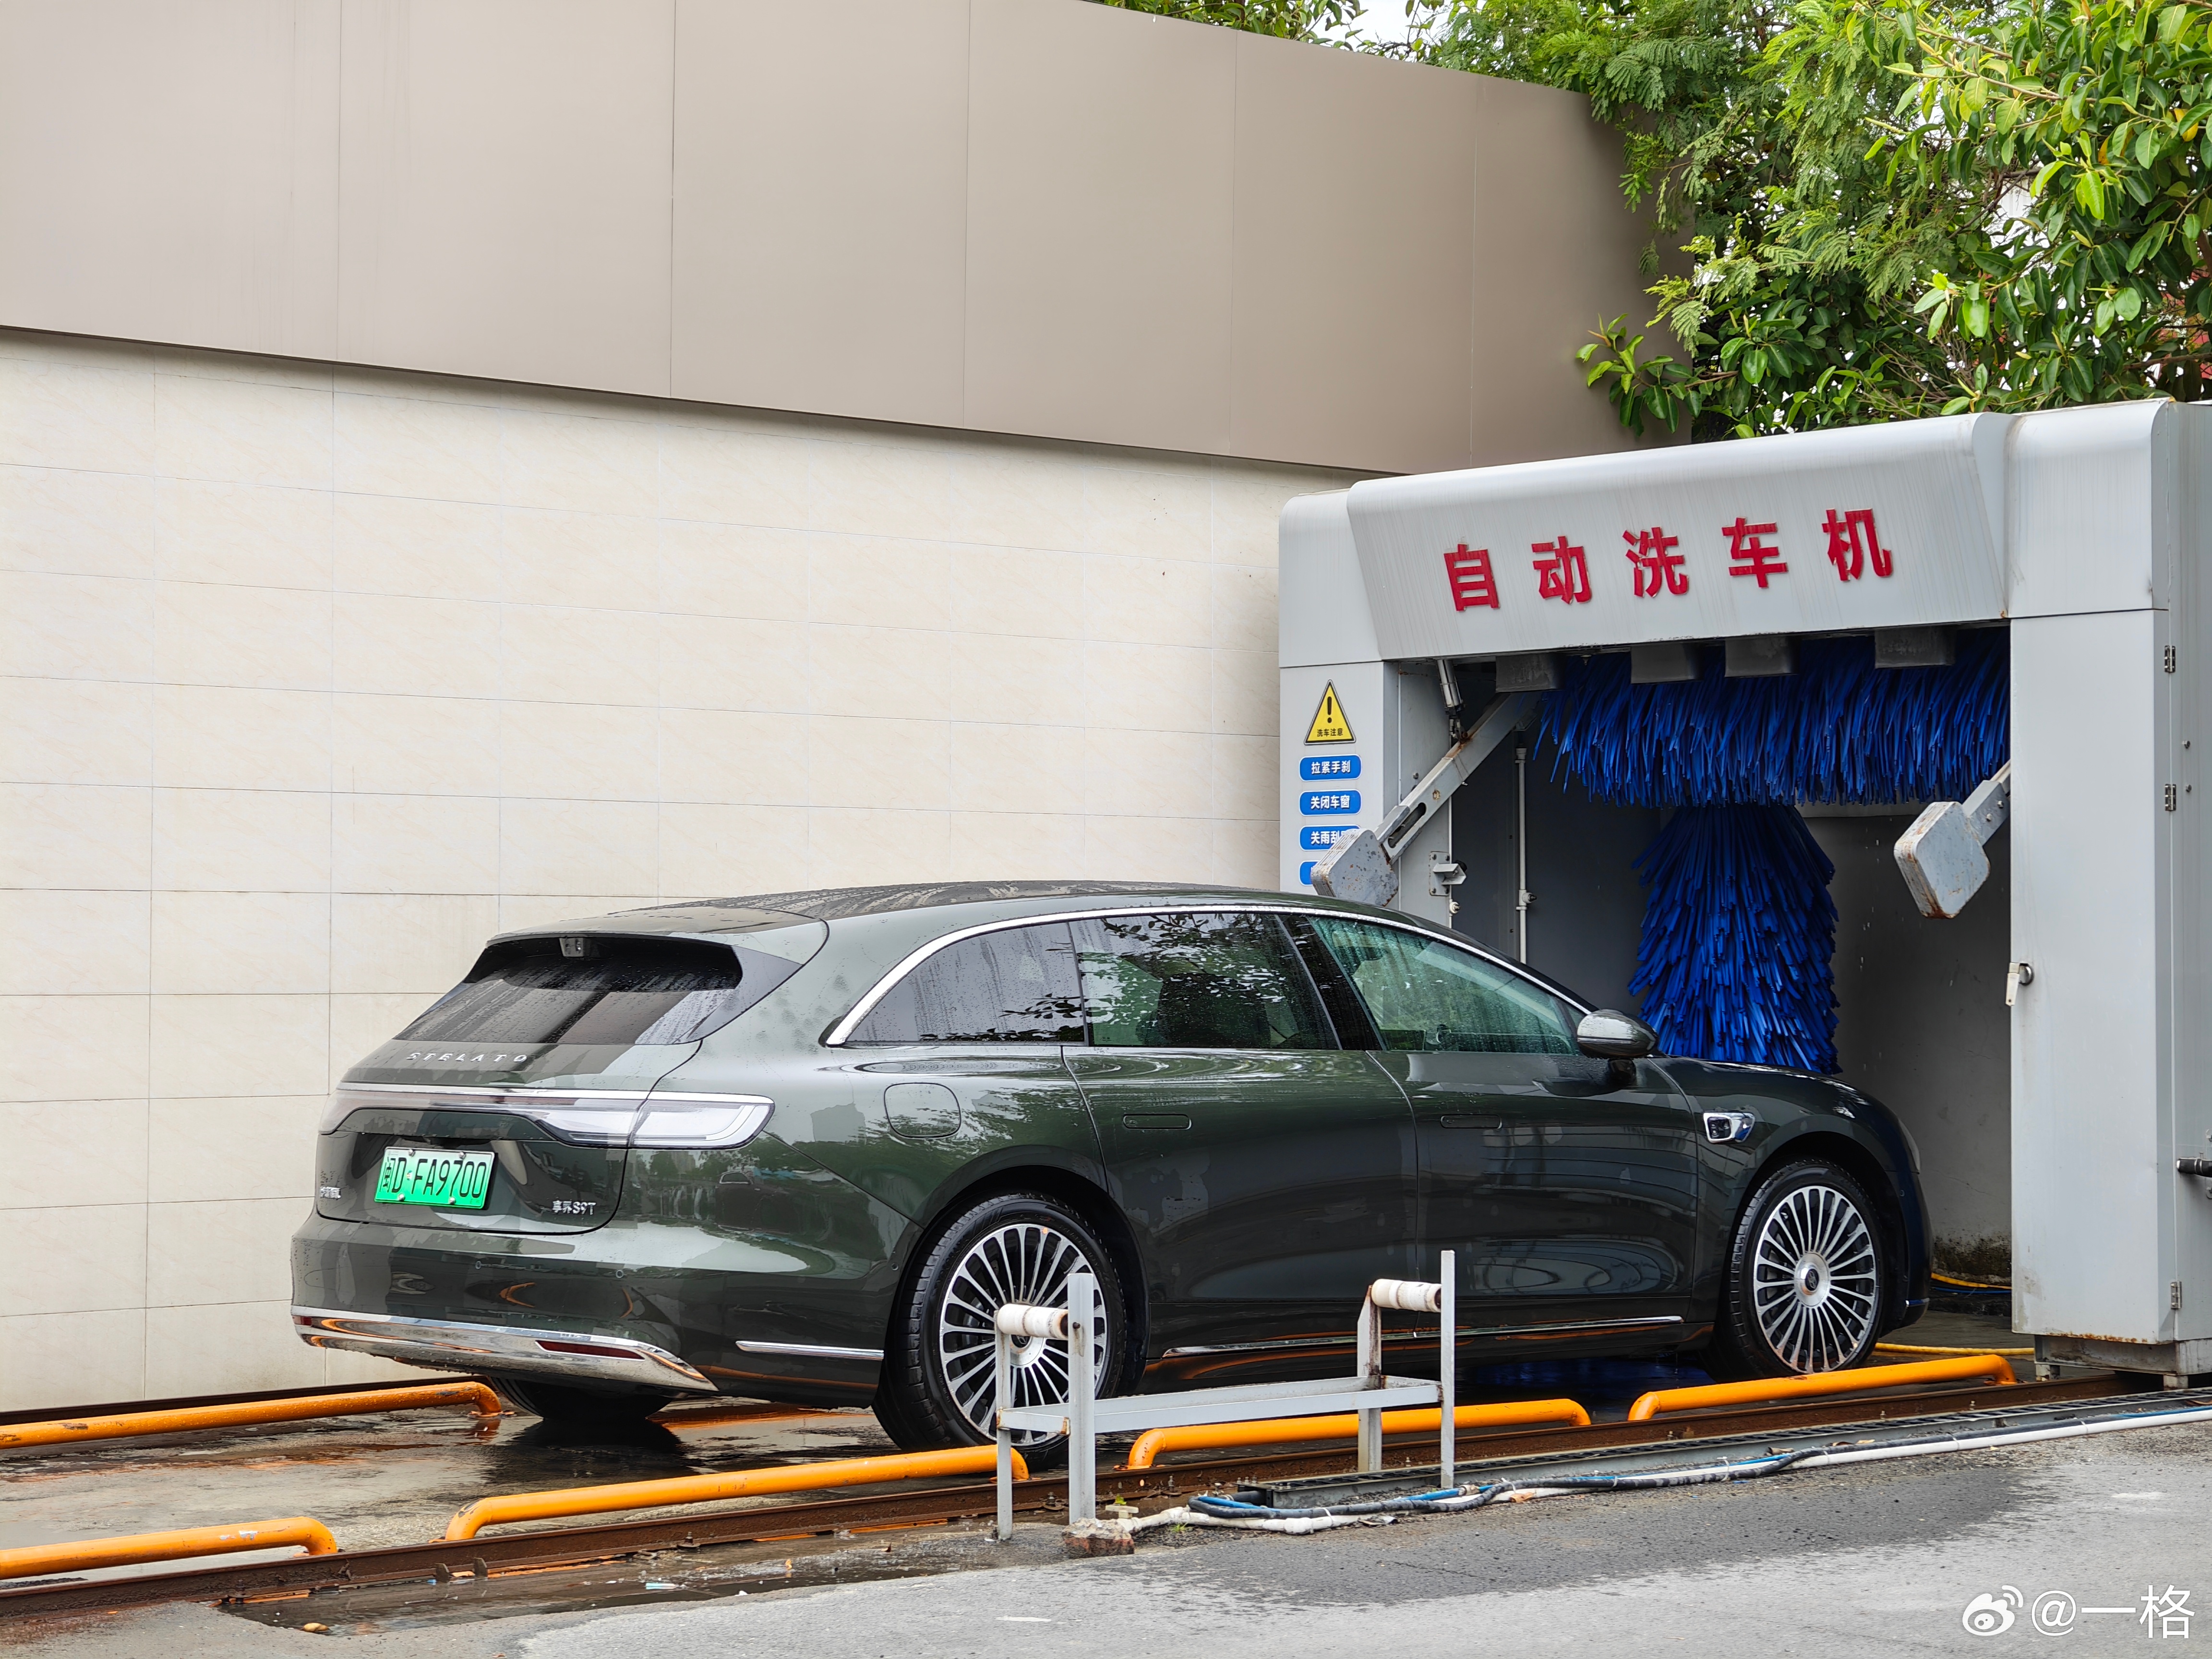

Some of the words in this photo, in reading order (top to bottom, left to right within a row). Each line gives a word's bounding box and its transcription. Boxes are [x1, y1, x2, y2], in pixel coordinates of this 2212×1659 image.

[1443, 508, 1894, 612] 自动洗车机
[1317, 728, 1344, 737] 洗车注意
[1311, 760, 1351, 774] 拉紧手刹
[1310, 794, 1350, 809] 关闭车窗
[1310, 830, 1346, 844] 关雨刮
[406, 1052, 528, 1063] STELATO
